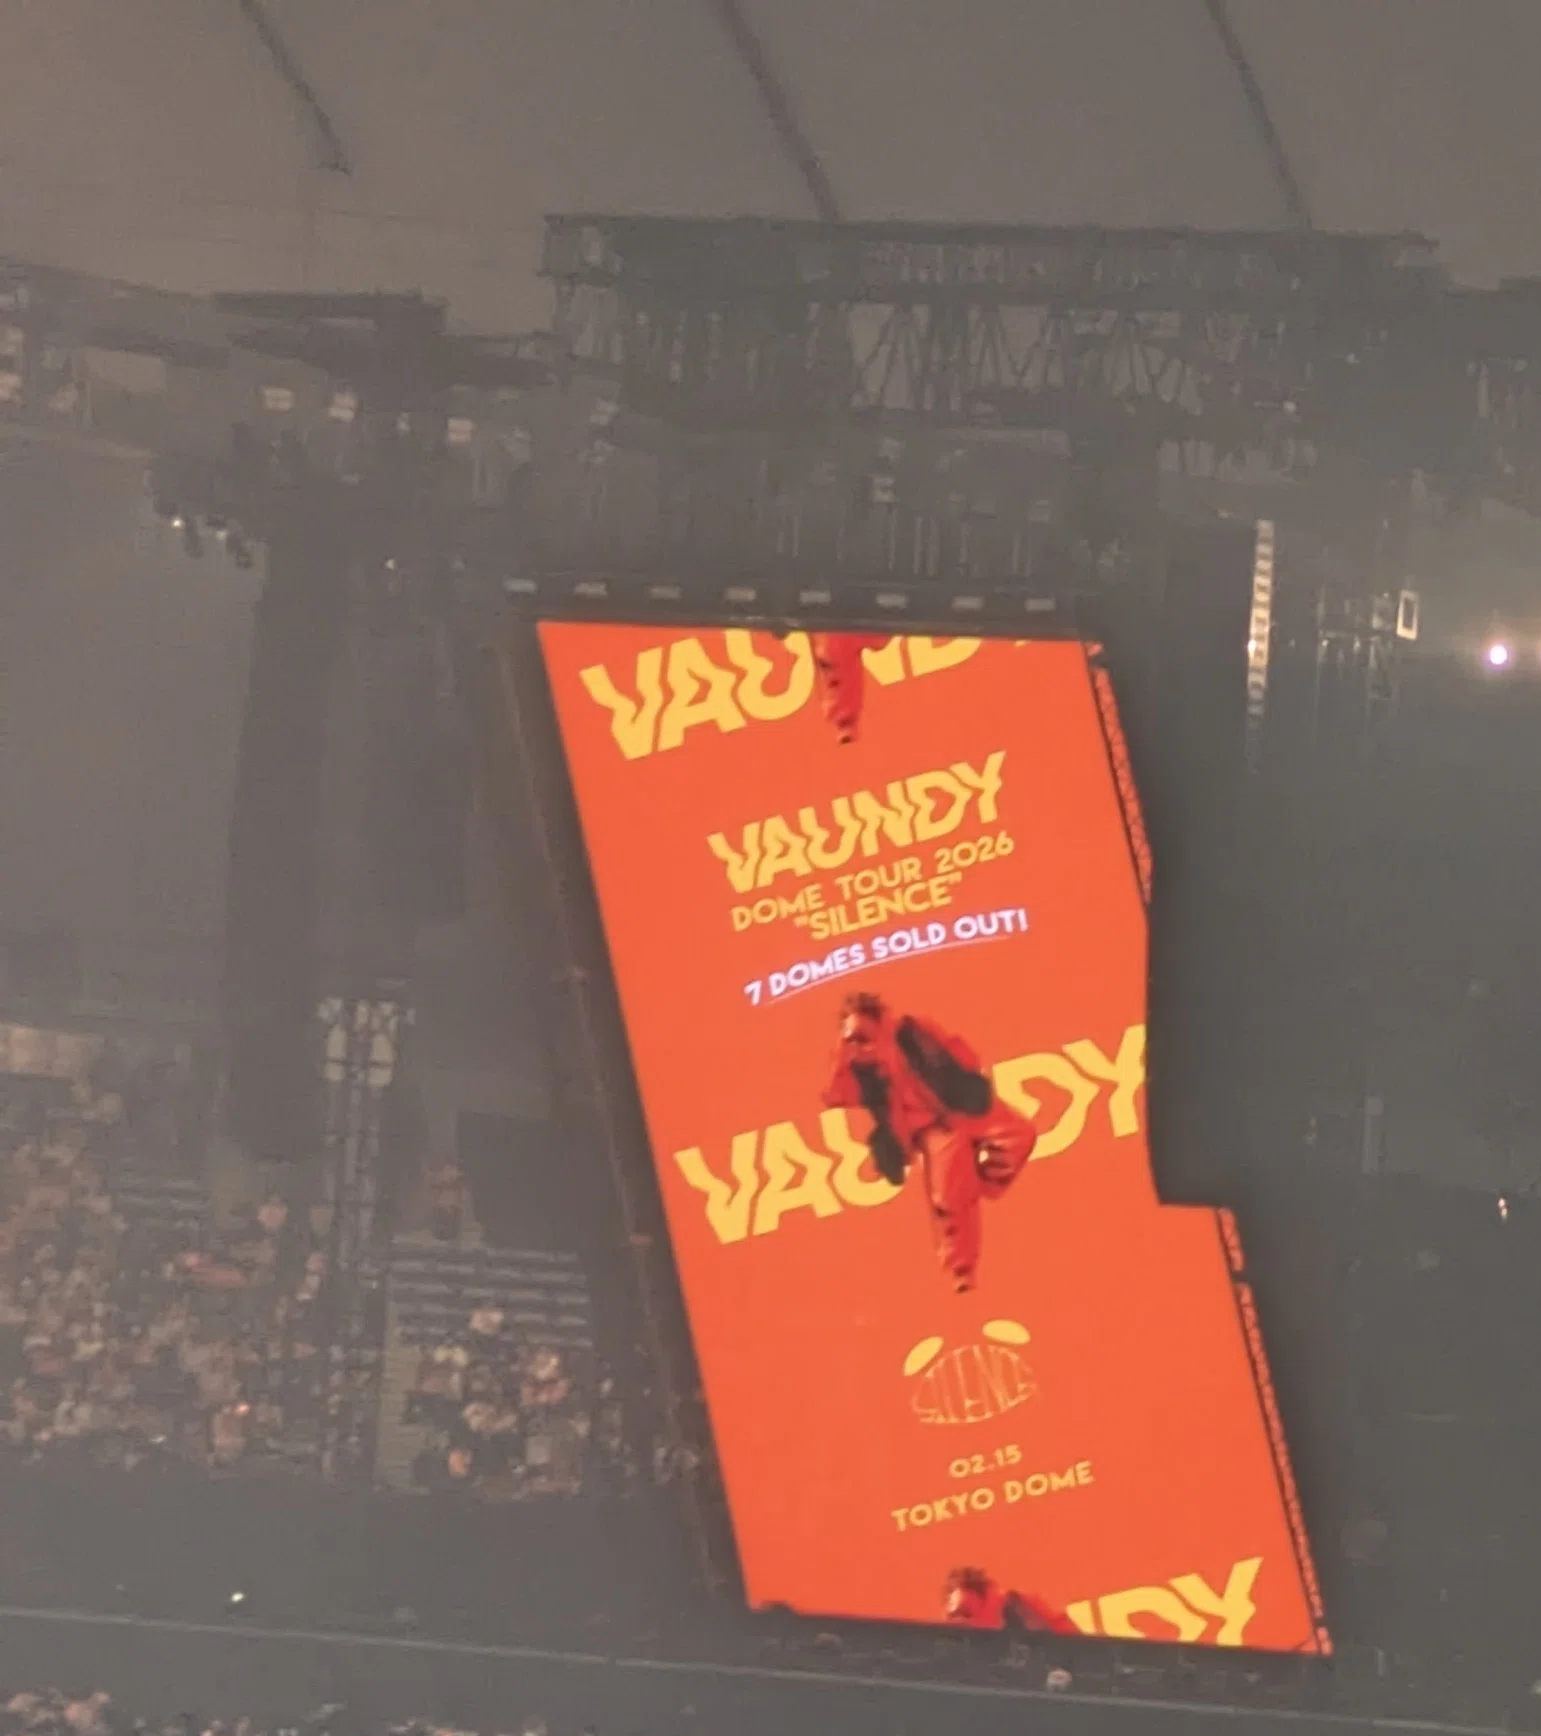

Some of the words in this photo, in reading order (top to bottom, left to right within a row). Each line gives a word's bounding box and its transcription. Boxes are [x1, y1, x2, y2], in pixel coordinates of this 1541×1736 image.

[707, 750, 1006, 893] VAUNDY
[731, 883, 825, 931] DOME
[835, 856, 923, 900] TOUR
[934, 830, 1015, 874] 2026
[743, 980, 763, 1006] 7
[768, 943, 866, 996] DOMES
[871, 922, 946, 960] SOLD
[953, 908, 1029, 940] OUT!
[891, 1488, 995, 1532] TOKYO
[1004, 1460, 1096, 1504] DOME
